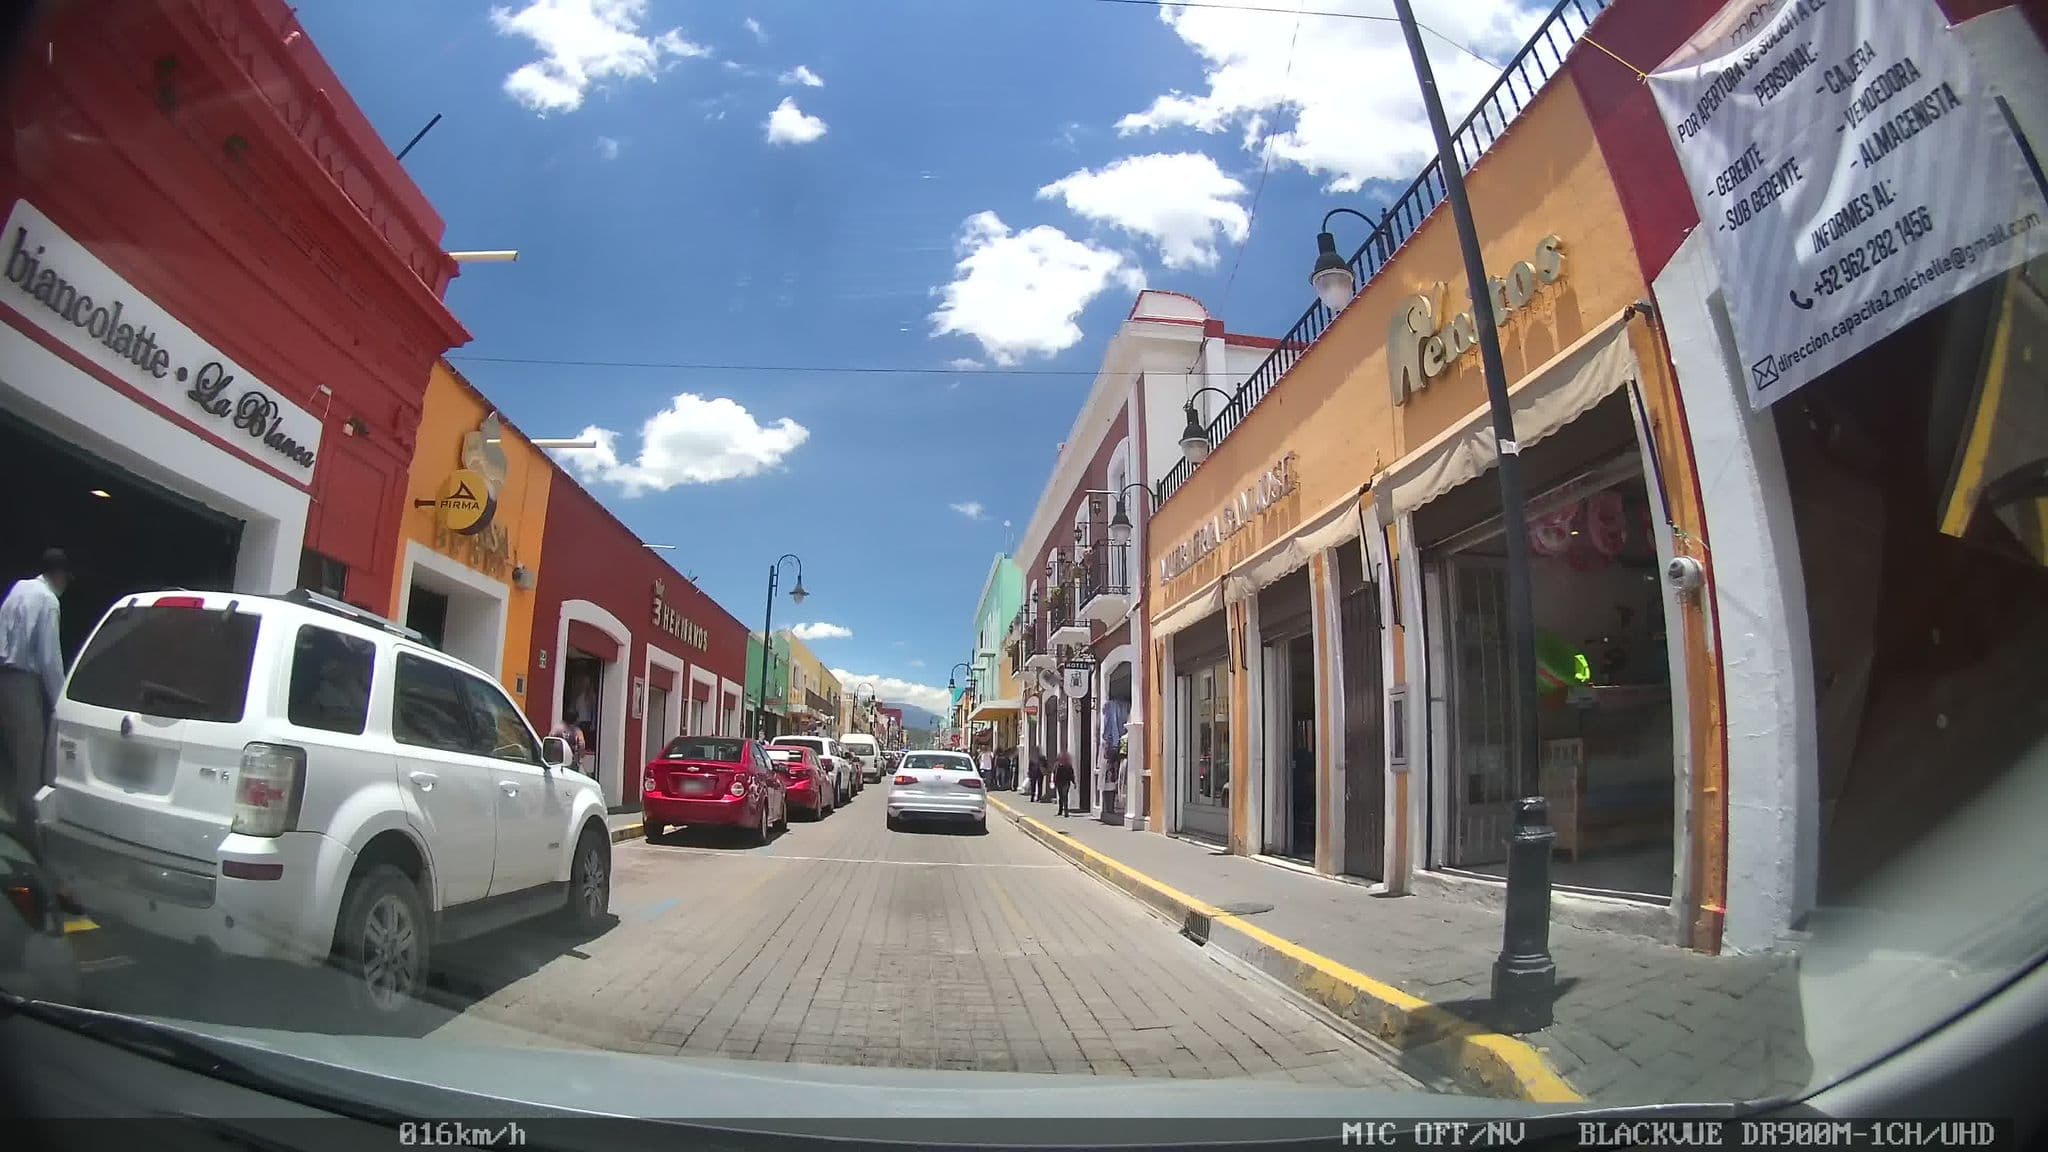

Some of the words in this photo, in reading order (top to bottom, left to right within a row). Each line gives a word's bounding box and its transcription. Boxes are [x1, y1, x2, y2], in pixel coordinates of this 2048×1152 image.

[1677, 110, 1702, 143] POR
[1698, 61, 1746, 125] APERTURA
[1754, 40, 1819, 108] PERSONAL:
[1824, 38, 1878, 96] CAJERA
[1843, 55, 1922, 131] VENDEDORA
[1858, 80, 1962, 170] ALMACENISTA
[1715, 142, 1765, 198] GERENTE
[1725, 207, 1752, 232] SUB
[1750, 155, 1804, 218] GERENTE
[1810, 190, 1874, 254] INFORMES
[1868, 177, 1899, 214] AL:
[1813, 260, 1845, 298] +52
[1842, 242, 1872, 280] 962
[1869, 227, 1900, 266] 282
[1896, 205, 1934, 248] 1456
[4, 226, 170, 379] biancolatte
[233, 390, 315, 468] Blanca
[440, 500, 480, 511] PIRMA
[651, 597, 662, 627] 3
[662, 603, 709, 653] HERMANOS
[1065, 661, 1089, 670] HOTEL
